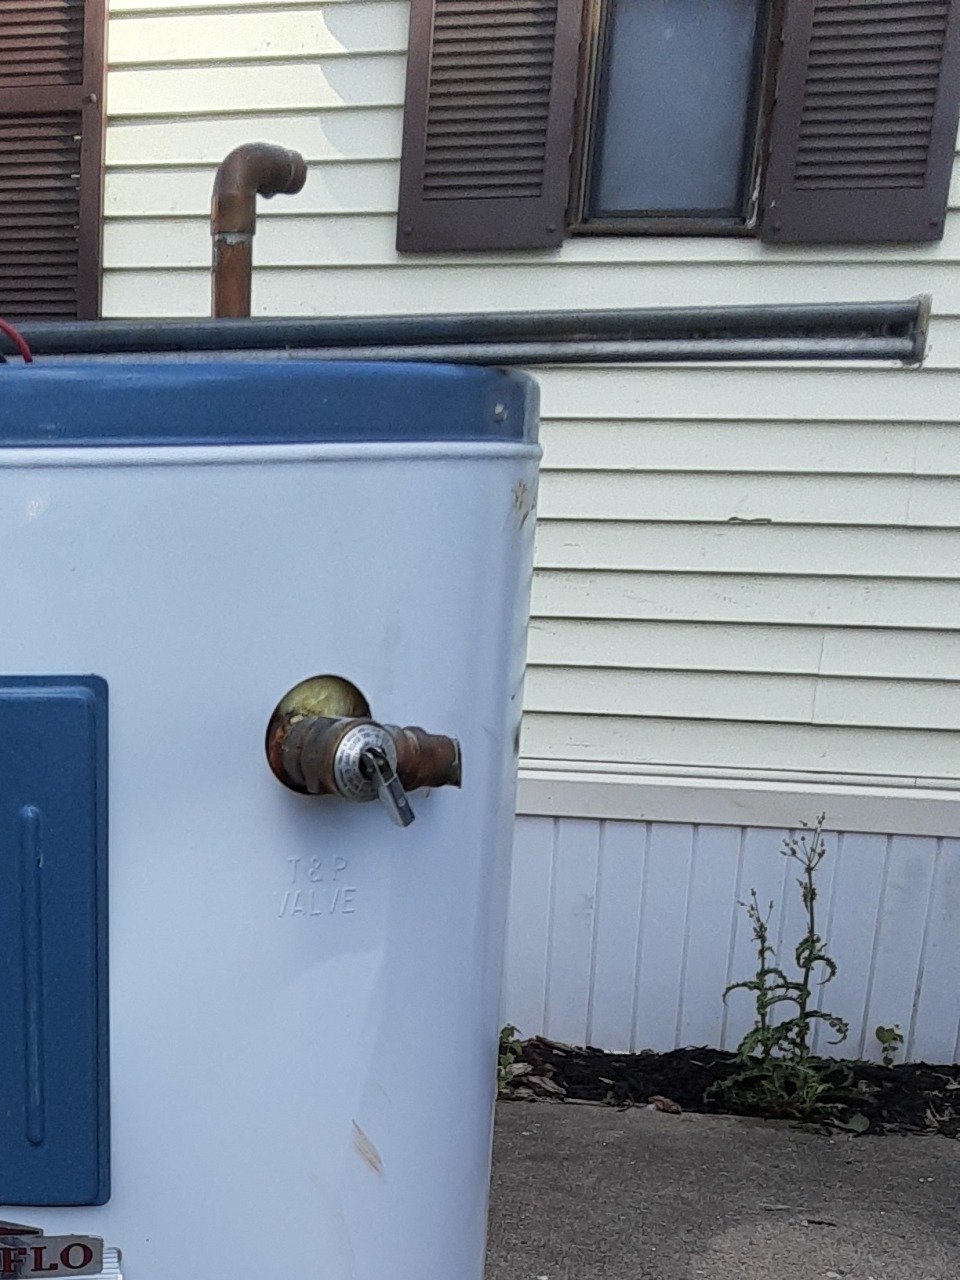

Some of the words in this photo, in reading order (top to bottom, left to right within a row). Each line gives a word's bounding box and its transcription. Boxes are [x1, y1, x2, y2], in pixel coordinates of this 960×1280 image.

[287, 856, 301, 884] T
[308, 855, 323, 883] &
[332, 854, 348, 881] P
[272, 887, 357, 918] VALVE
